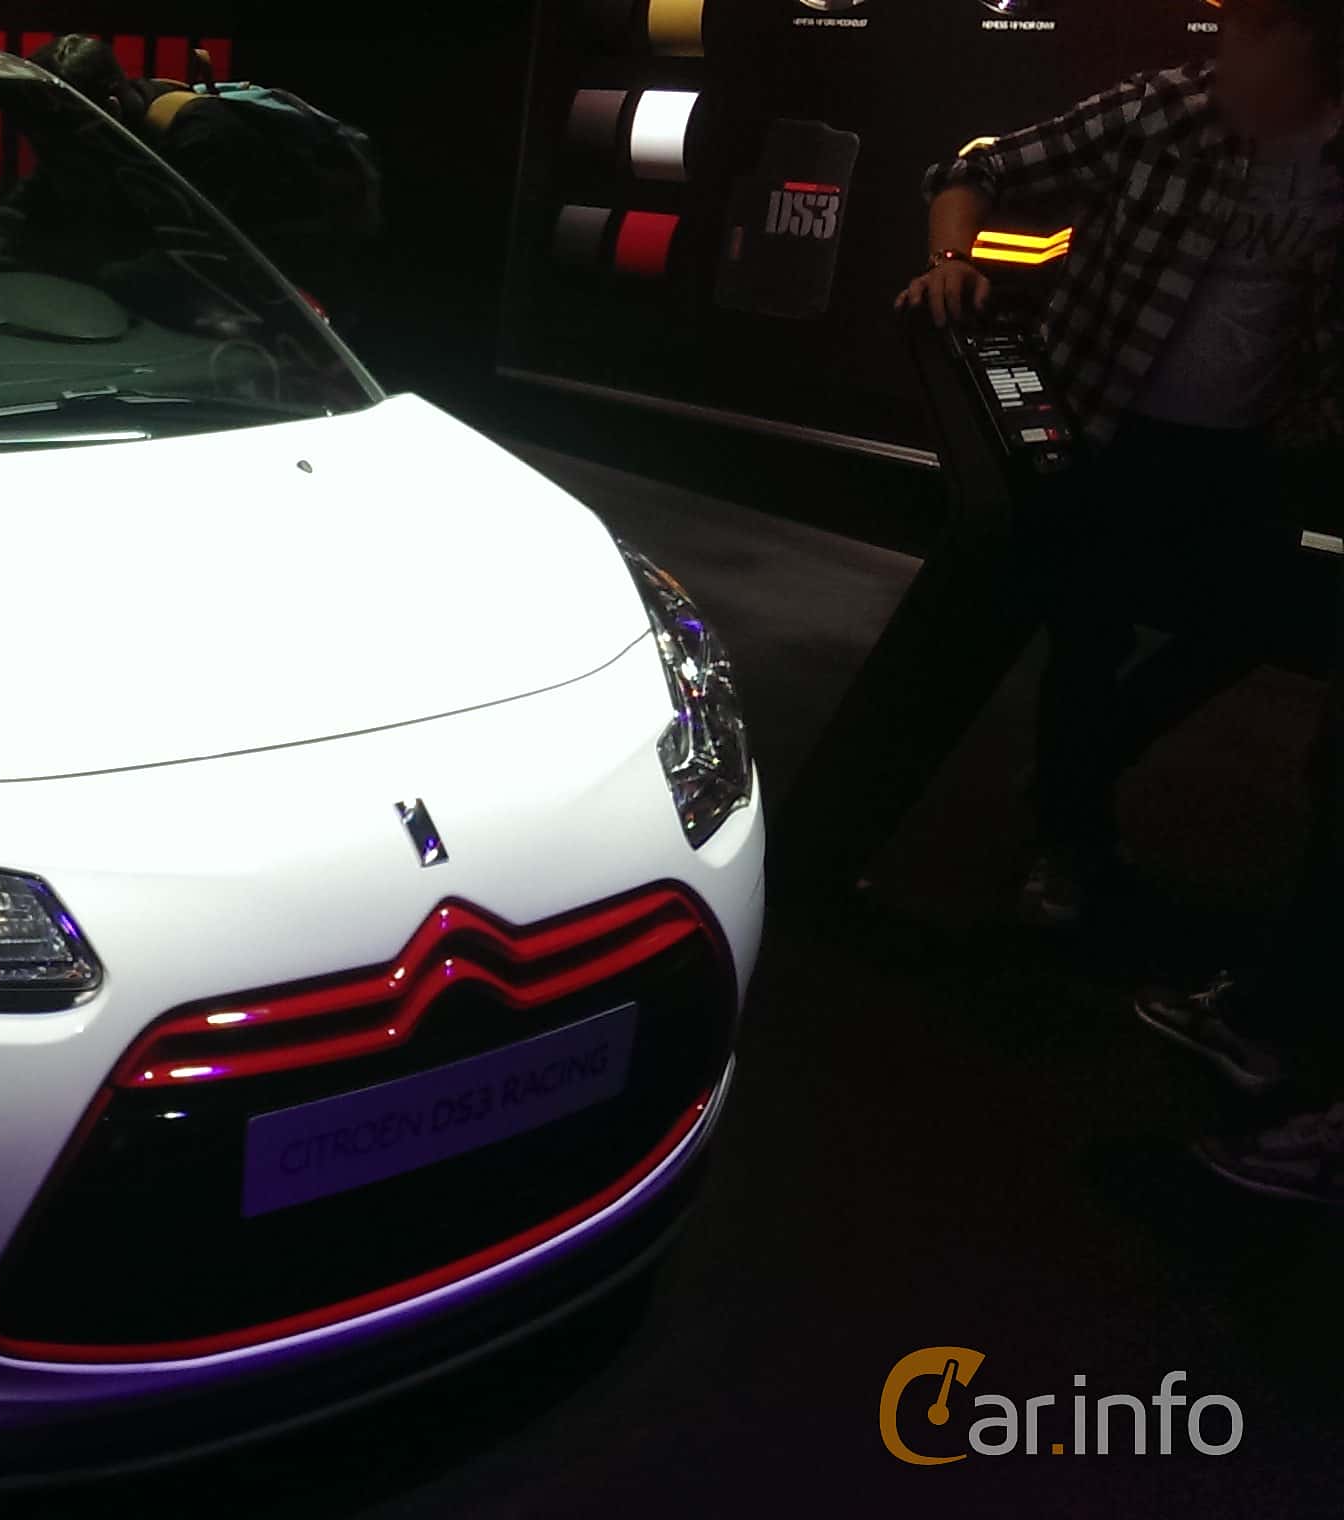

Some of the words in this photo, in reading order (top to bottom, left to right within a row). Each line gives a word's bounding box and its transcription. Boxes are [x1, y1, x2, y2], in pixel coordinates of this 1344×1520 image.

[764, 189, 841, 239] DS3
[431, 1086, 494, 1134] DS3
[500, 1042, 609, 1109] RACING
